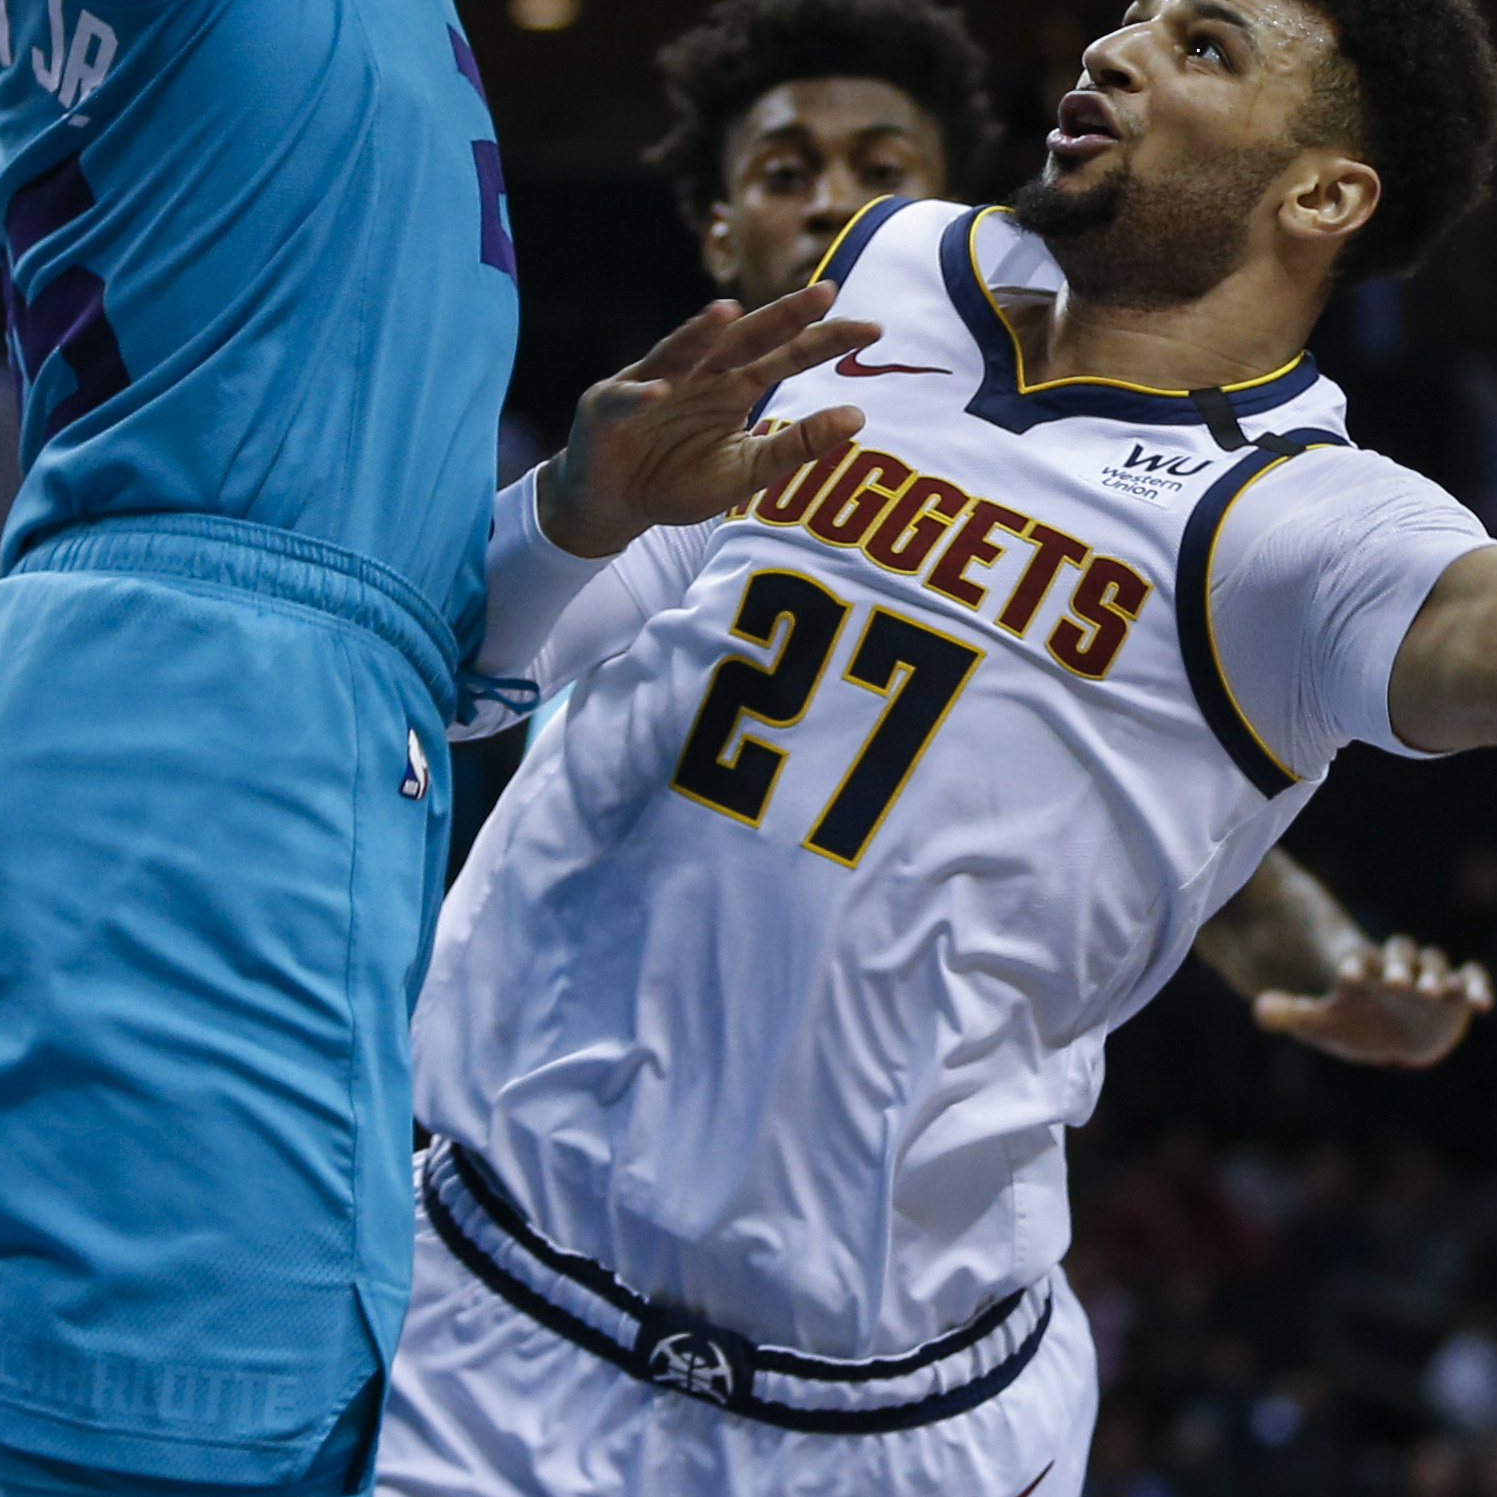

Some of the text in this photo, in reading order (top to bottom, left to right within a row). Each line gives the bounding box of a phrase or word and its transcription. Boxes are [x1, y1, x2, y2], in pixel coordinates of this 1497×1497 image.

[1122, 442, 1216, 477] WU
[1101, 466, 1184, 493] Western
[1101, 478, 1159, 501] Union
[669, 566, 988, 870] 27
